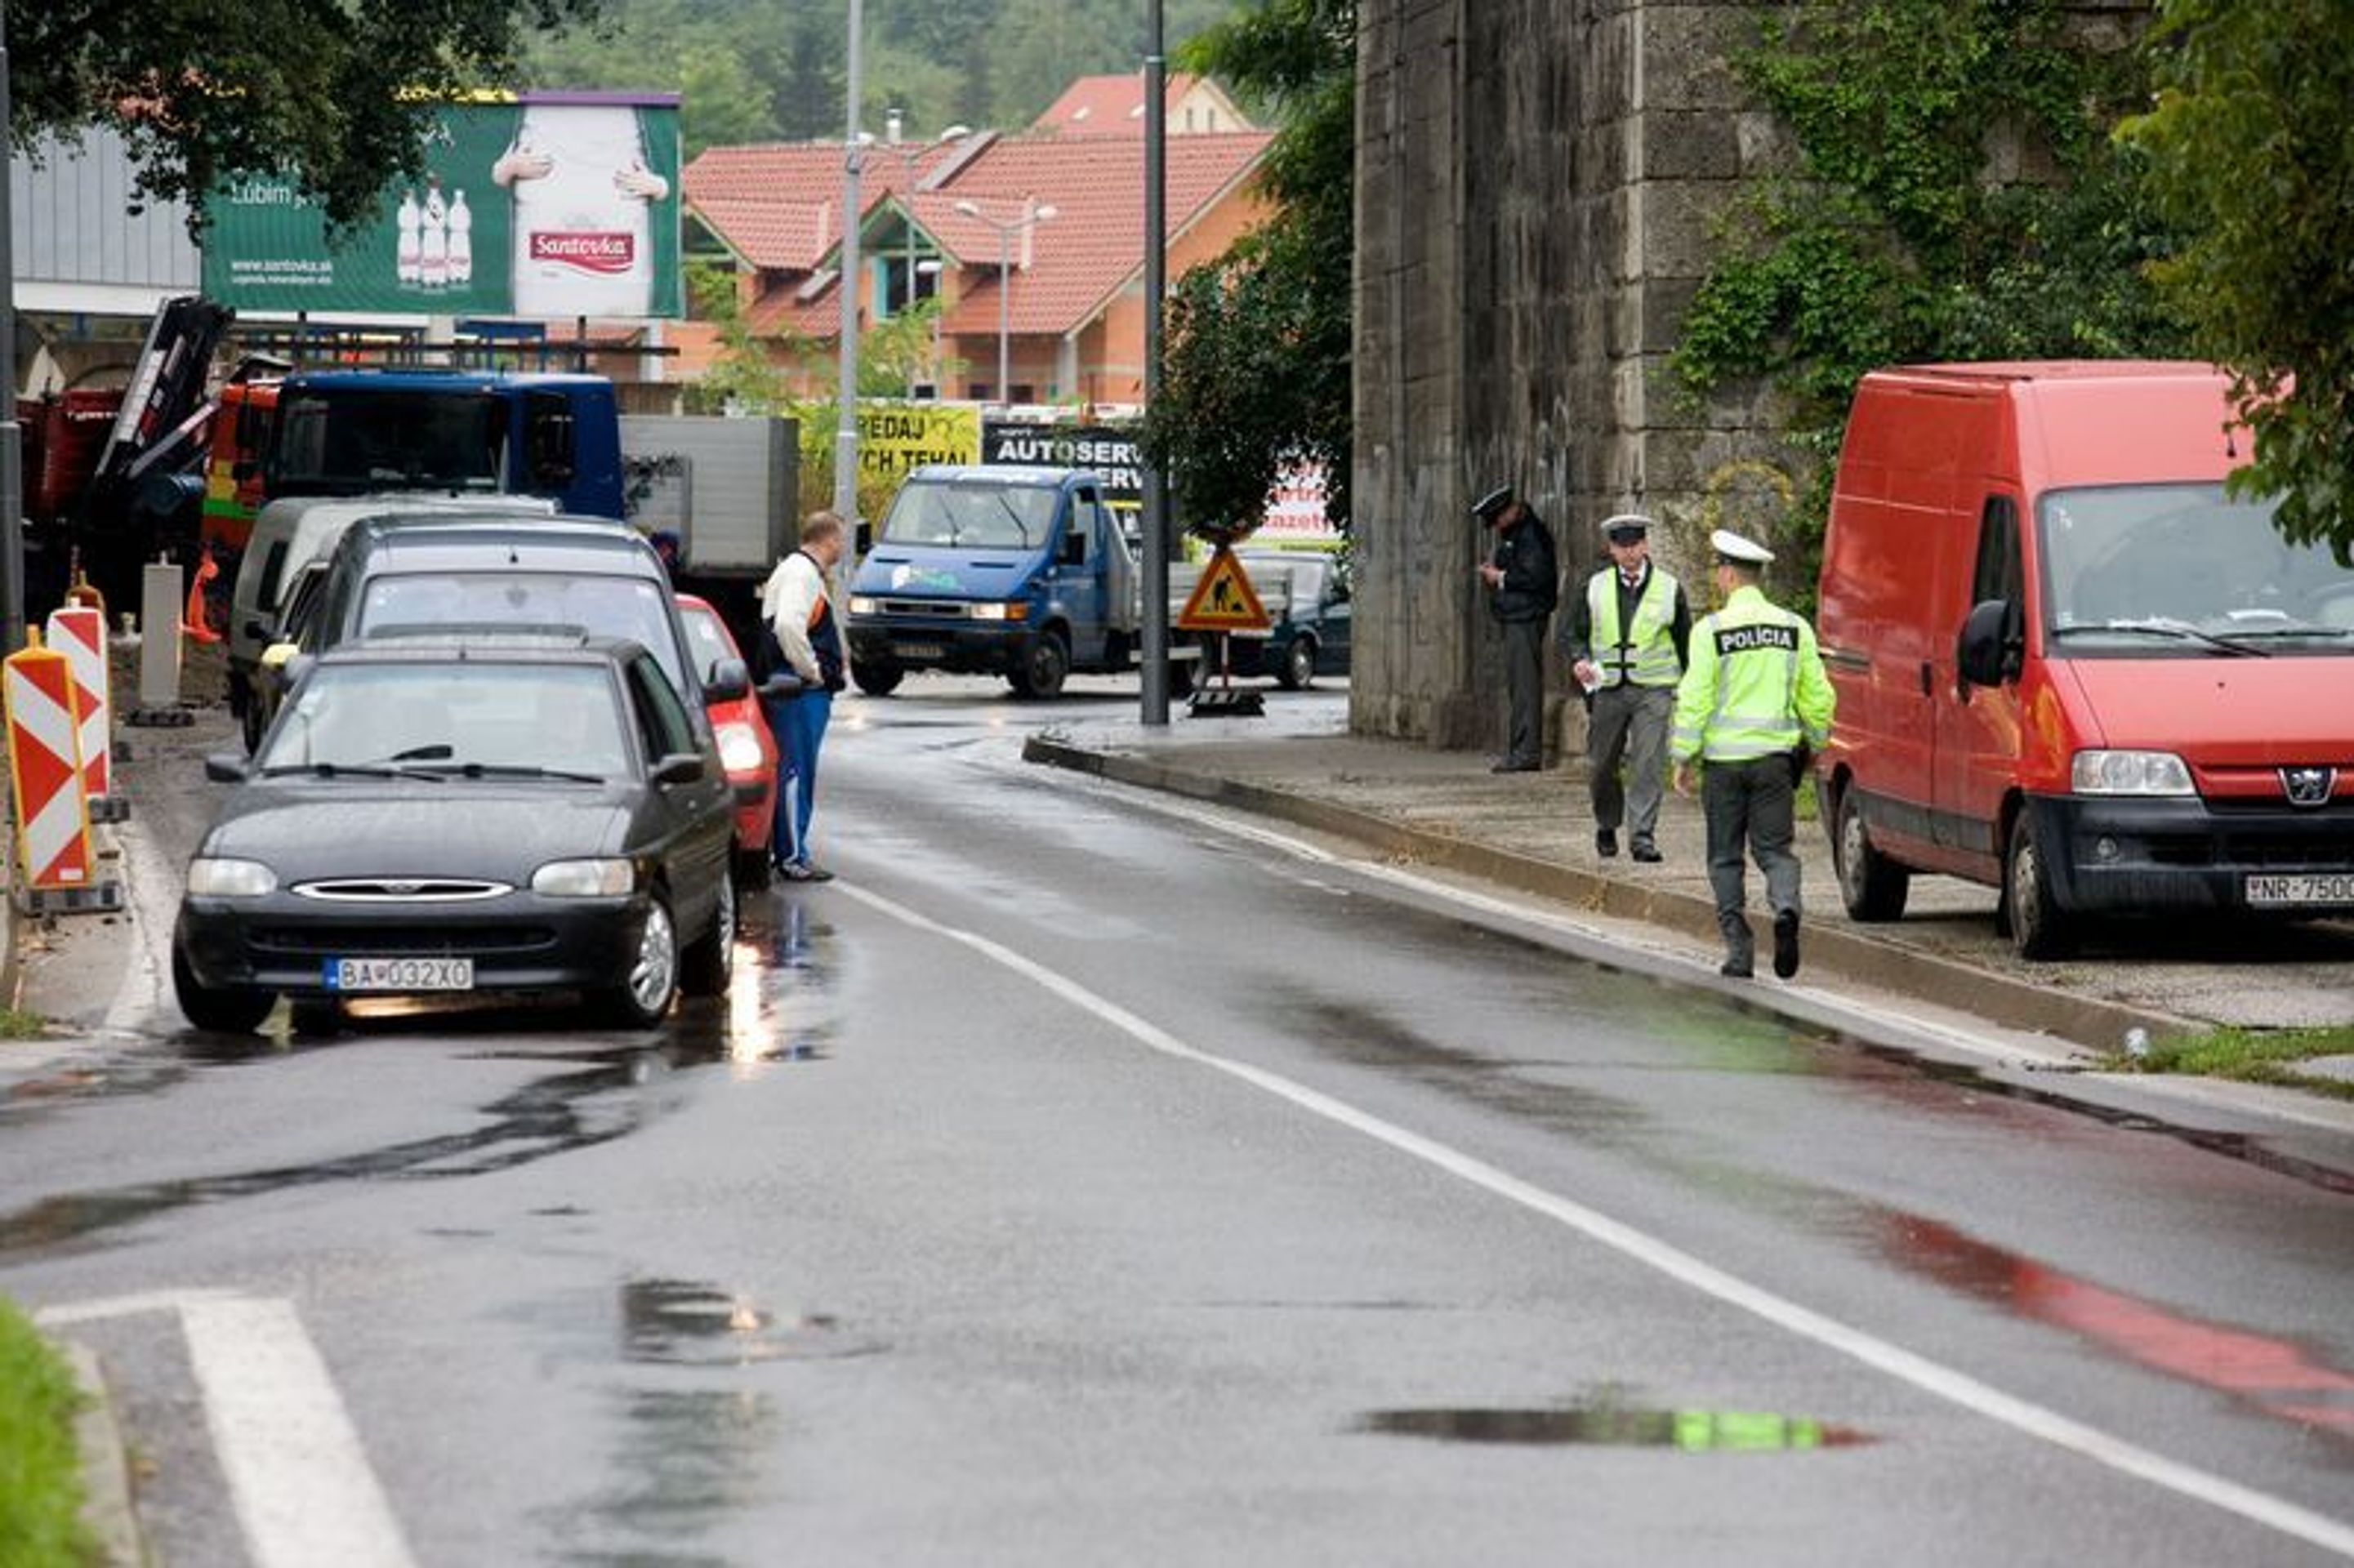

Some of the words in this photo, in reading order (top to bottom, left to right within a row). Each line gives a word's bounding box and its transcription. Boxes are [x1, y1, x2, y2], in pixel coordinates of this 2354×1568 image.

[536, 235, 626, 255] Santovka
[859, 414, 925, 440] REDAJ
[860, 449, 894, 472] CH
[997, 439, 1143, 464] AUTOSERV
[1099, 467, 1143, 489] ERV
[1721, 626, 1792, 652] POLÍCIA
